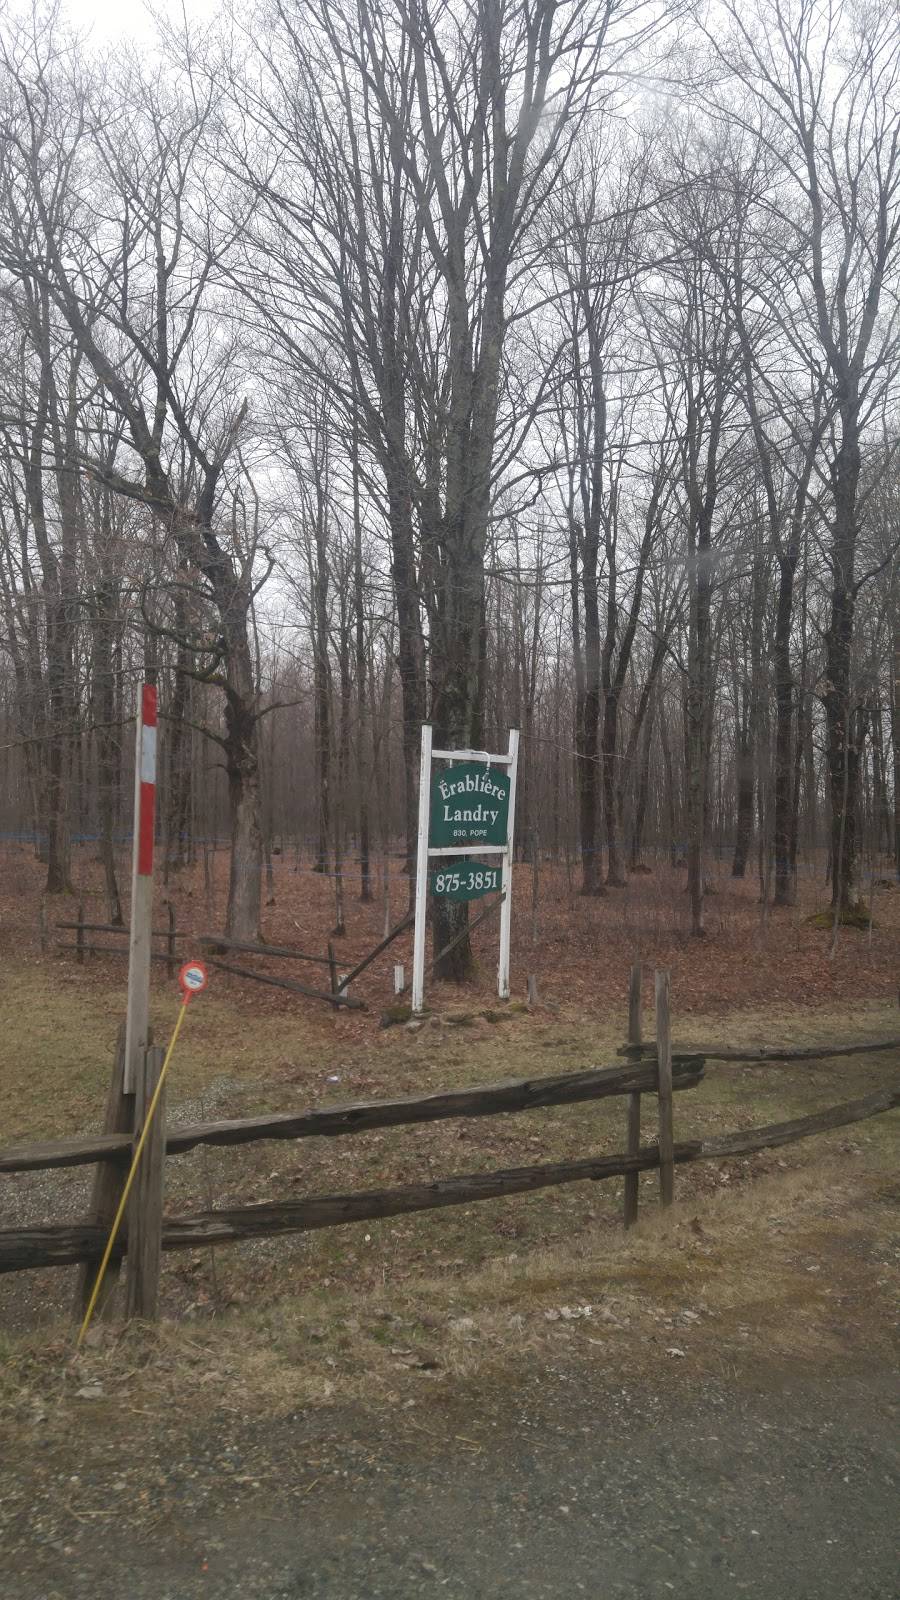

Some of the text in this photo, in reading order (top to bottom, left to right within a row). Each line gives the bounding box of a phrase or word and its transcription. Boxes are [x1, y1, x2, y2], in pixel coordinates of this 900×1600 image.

[438, 774, 506, 800] Érablière
[443, 804, 499, 825] Landry
[469, 829, 488, 837] POPE
[435, 871, 497, 892] 875-3851
